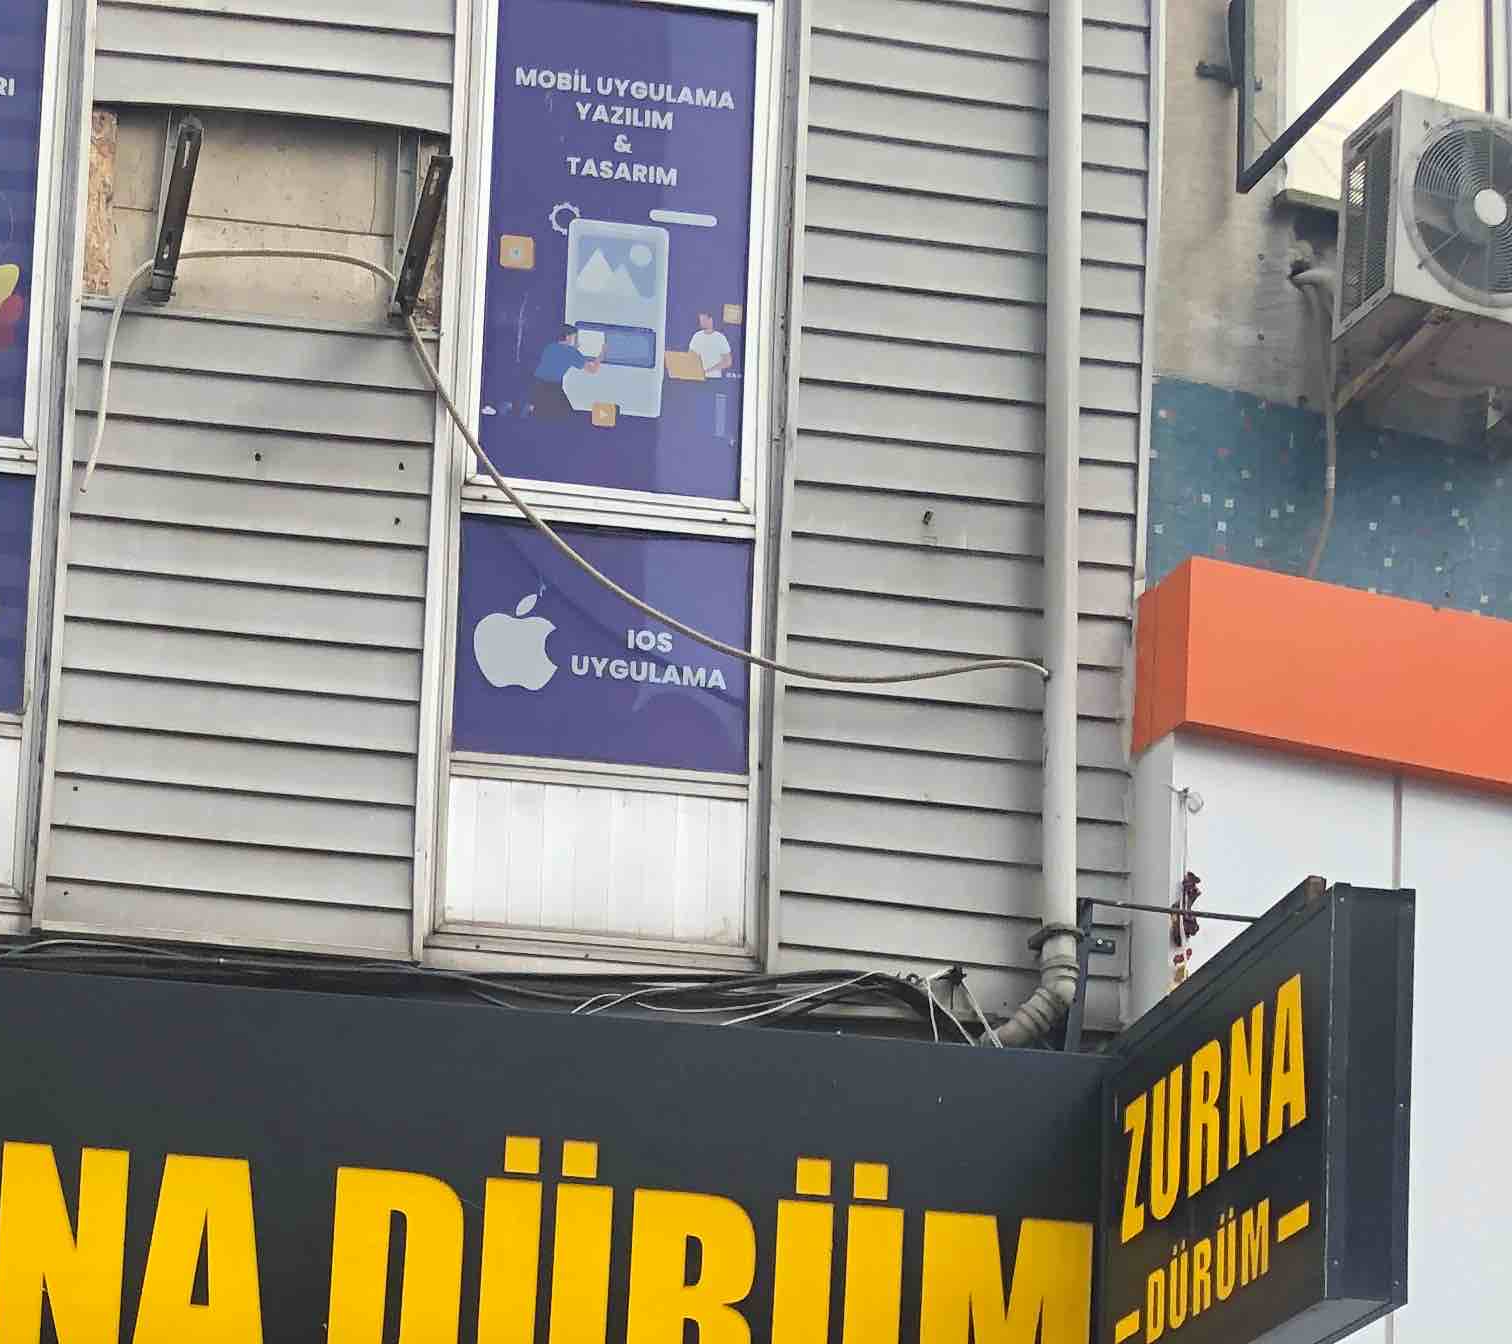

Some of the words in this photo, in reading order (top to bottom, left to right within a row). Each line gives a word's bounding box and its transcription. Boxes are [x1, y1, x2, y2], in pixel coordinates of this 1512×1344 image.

[514, 66, 592, 96] MOBİL
[595, 77, 735, 111] UYGULAMA
[575, 102, 674, 131] YAZILIM
[614, 135, 633, 155] &
[566, 156, 678, 187] TASARIM
[626, 629, 674, 653] IOS
[570, 654, 727, 691] UYGULAMA
[1120, 973, 1307, 1244] ZURNA
